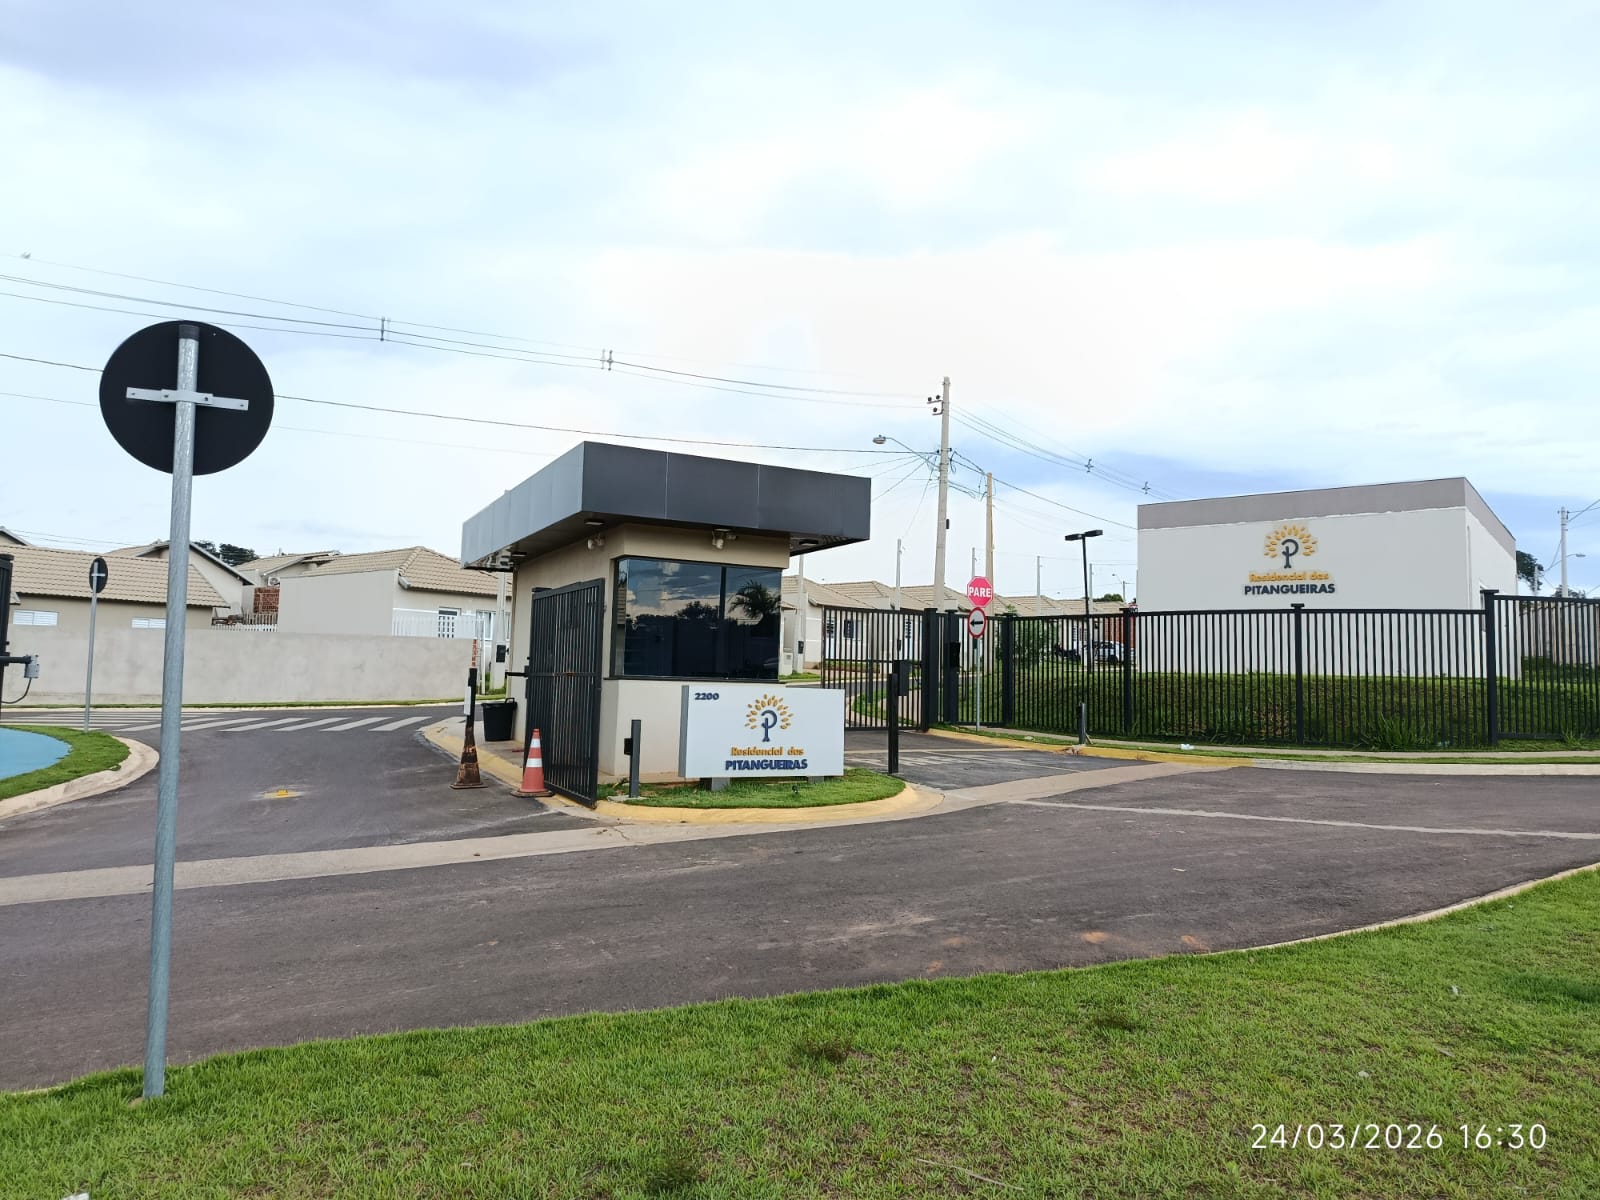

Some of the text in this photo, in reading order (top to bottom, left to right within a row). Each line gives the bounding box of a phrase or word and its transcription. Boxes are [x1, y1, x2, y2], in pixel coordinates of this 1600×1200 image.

[1249, 572, 1306, 582] Residencial
[968, 586, 992, 598] PARE
[1244, 583, 1336, 595] PITANGUEIRAS
[694, 692, 720, 701] 2200
[730, 746, 783, 756] Residencial
[725, 759, 808, 770] PITANGUEIRAS
